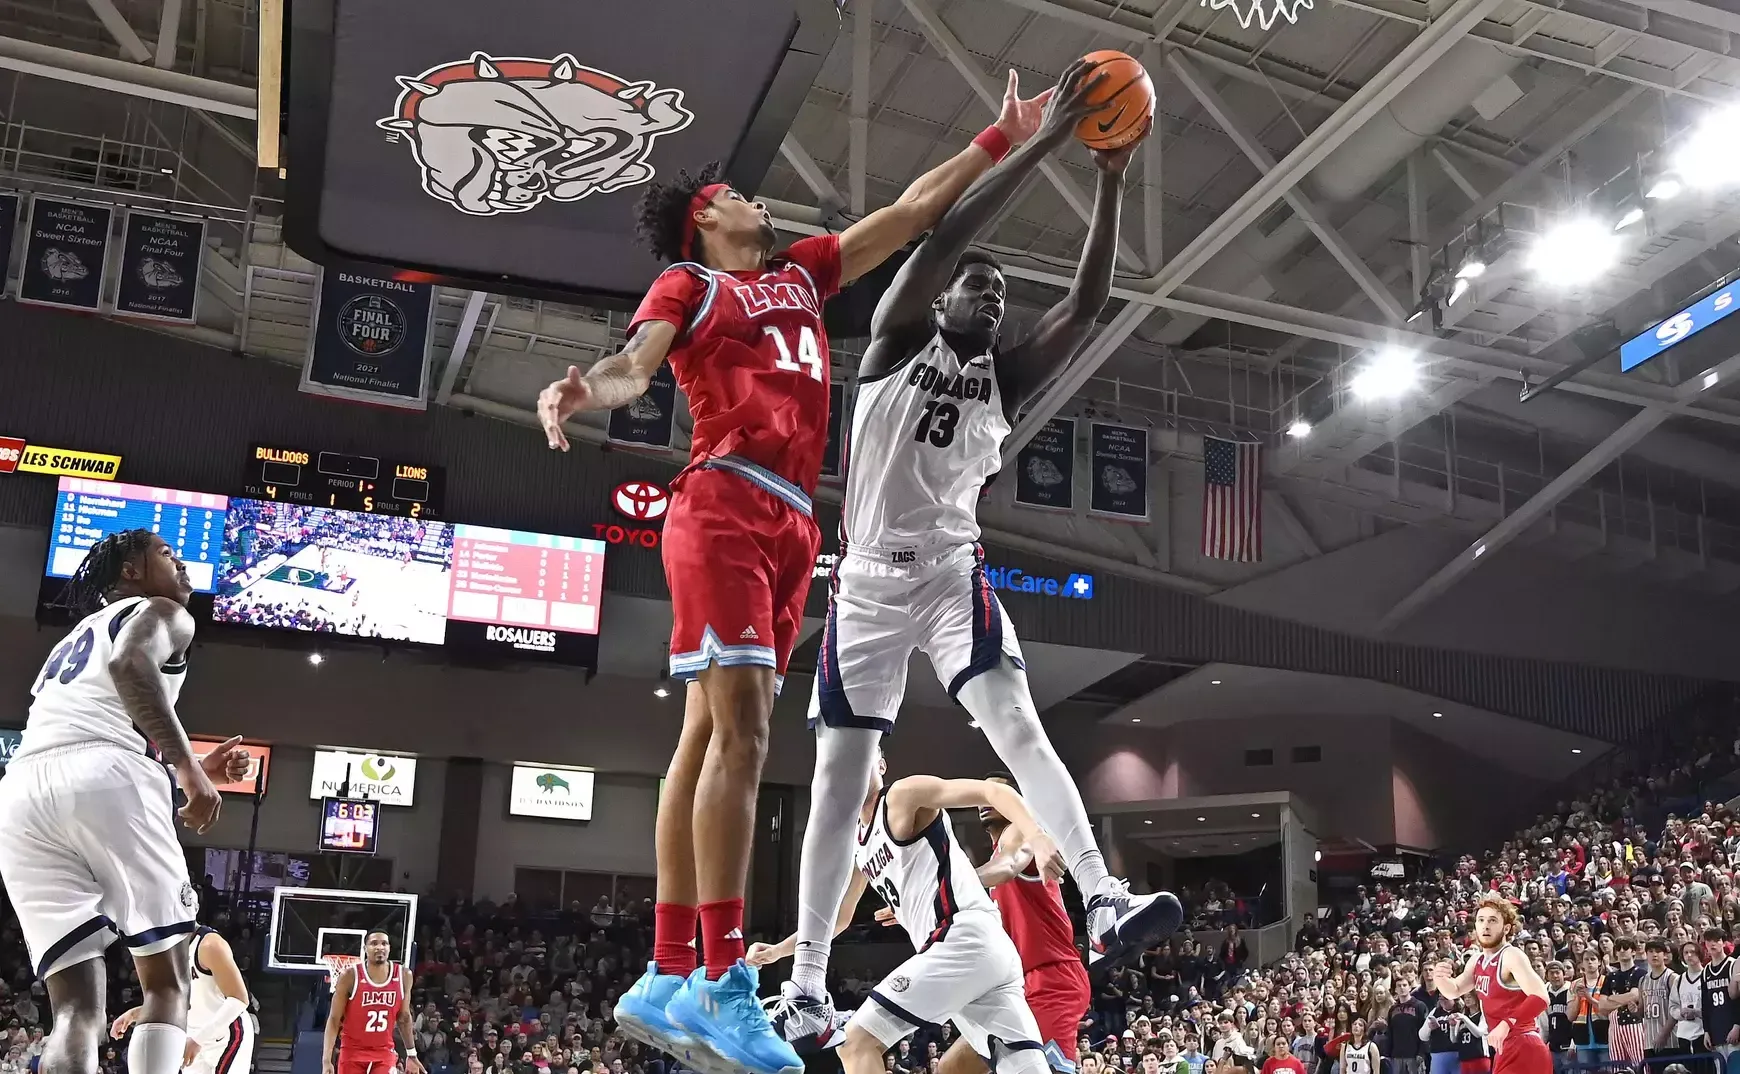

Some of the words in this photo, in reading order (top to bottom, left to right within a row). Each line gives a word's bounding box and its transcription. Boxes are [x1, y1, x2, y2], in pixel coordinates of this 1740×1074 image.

[48, 212, 96, 224] BASKETBALL
[56, 223, 85, 234] NCAA
[142, 225, 189, 238] BASKETBALL
[36, 230, 65, 243] Sweet
[68, 234, 102, 246] Sixteen
[150, 236, 178, 247] NCAA
[140, 244, 162, 254] Final
[164, 248, 184, 257] Four
[339, 273, 416, 292] BASKETBALL
[128, 301, 156, 311] National
[158, 305, 183, 314] Finalist
[734, 283, 820, 318] LMU
[353, 309, 392, 326] FINAL
[352, 324, 390, 340] FOUR
[762, 326, 823, 384] 14
[356, 364, 378, 373] 2021
[333, 372, 368, 384] National
[370, 378, 400, 388] Finalist
[650, 380, 670, 388] xteen
[914, 400, 960, 448] 13
[1034, 435, 1058, 444] NCAA
[256, 447, 309, 464] BULLDOGS
[1108, 444, 1131, 452] NCAA
[22, 452, 48, 466] LES
[50, 456, 115, 474] SCHWAB
[396, 465, 427, 480] LIONS
[266, 486, 276, 498] 4
[328, 478, 354, 488] PERIOD
[358, 480, 364, 492] 1
[290, 491, 314, 500] FOULS
[330, 494, 336, 506] 1
[364, 496, 374, 512] 5
[376, 501, 400, 511] FOULS
[410, 502, 421, 518] 2
[592, 524, 661, 548] TOYO
[892, 551, 916, 563] ZAGS
[984, 564, 1058, 596] ltiCare
[486, 625, 556, 647] ROSAUERS
[322, 780, 402, 796] NUMERICA
[536, 798, 584, 808] DAVIDSON
[338, 803, 374, 820] 6:03
[1475, 976, 1490, 996] MU
[362, 991, 396, 1007] LMU
[1712, 991, 1725, 1006] 99
[364, 1010, 388, 1032] 25
[1552, 1016, 1556, 1029] 4
[1462, 1032, 1471, 1044] 33
[1352, 1062, 1358, 1072] 0
